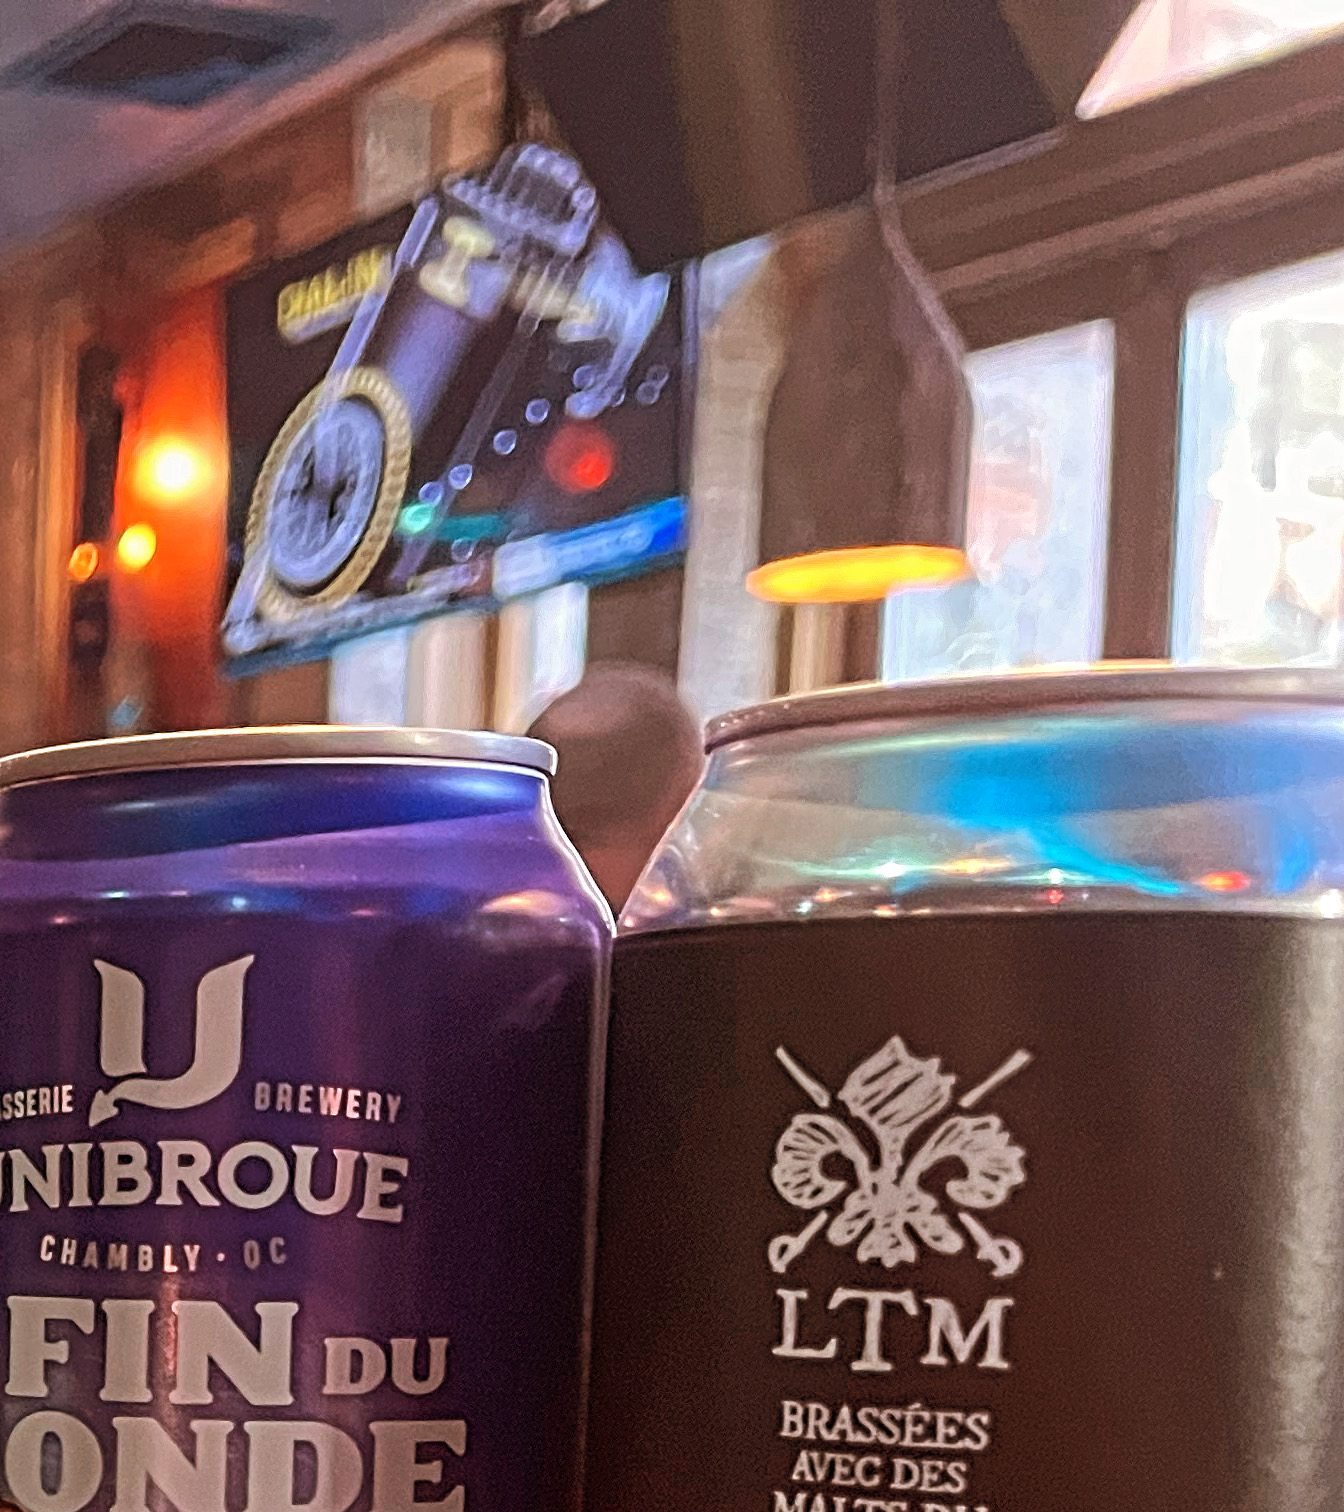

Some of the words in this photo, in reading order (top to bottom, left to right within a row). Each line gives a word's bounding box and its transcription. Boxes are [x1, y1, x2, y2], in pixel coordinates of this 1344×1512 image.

[254, 1082, 401, 1124] BREWERY
[40, 1234, 201, 1273] CHAMBLY
[5, 1296, 299, 1406] FIN
[322, 1337, 449, 1396] DU
[771, 1287, 1014, 1371] LTM
[780, 1400, 991, 1451] BRASSÉES
[791, 1449, 882, 1490] AVEC
[890, 1454, 968, 1494] DES
